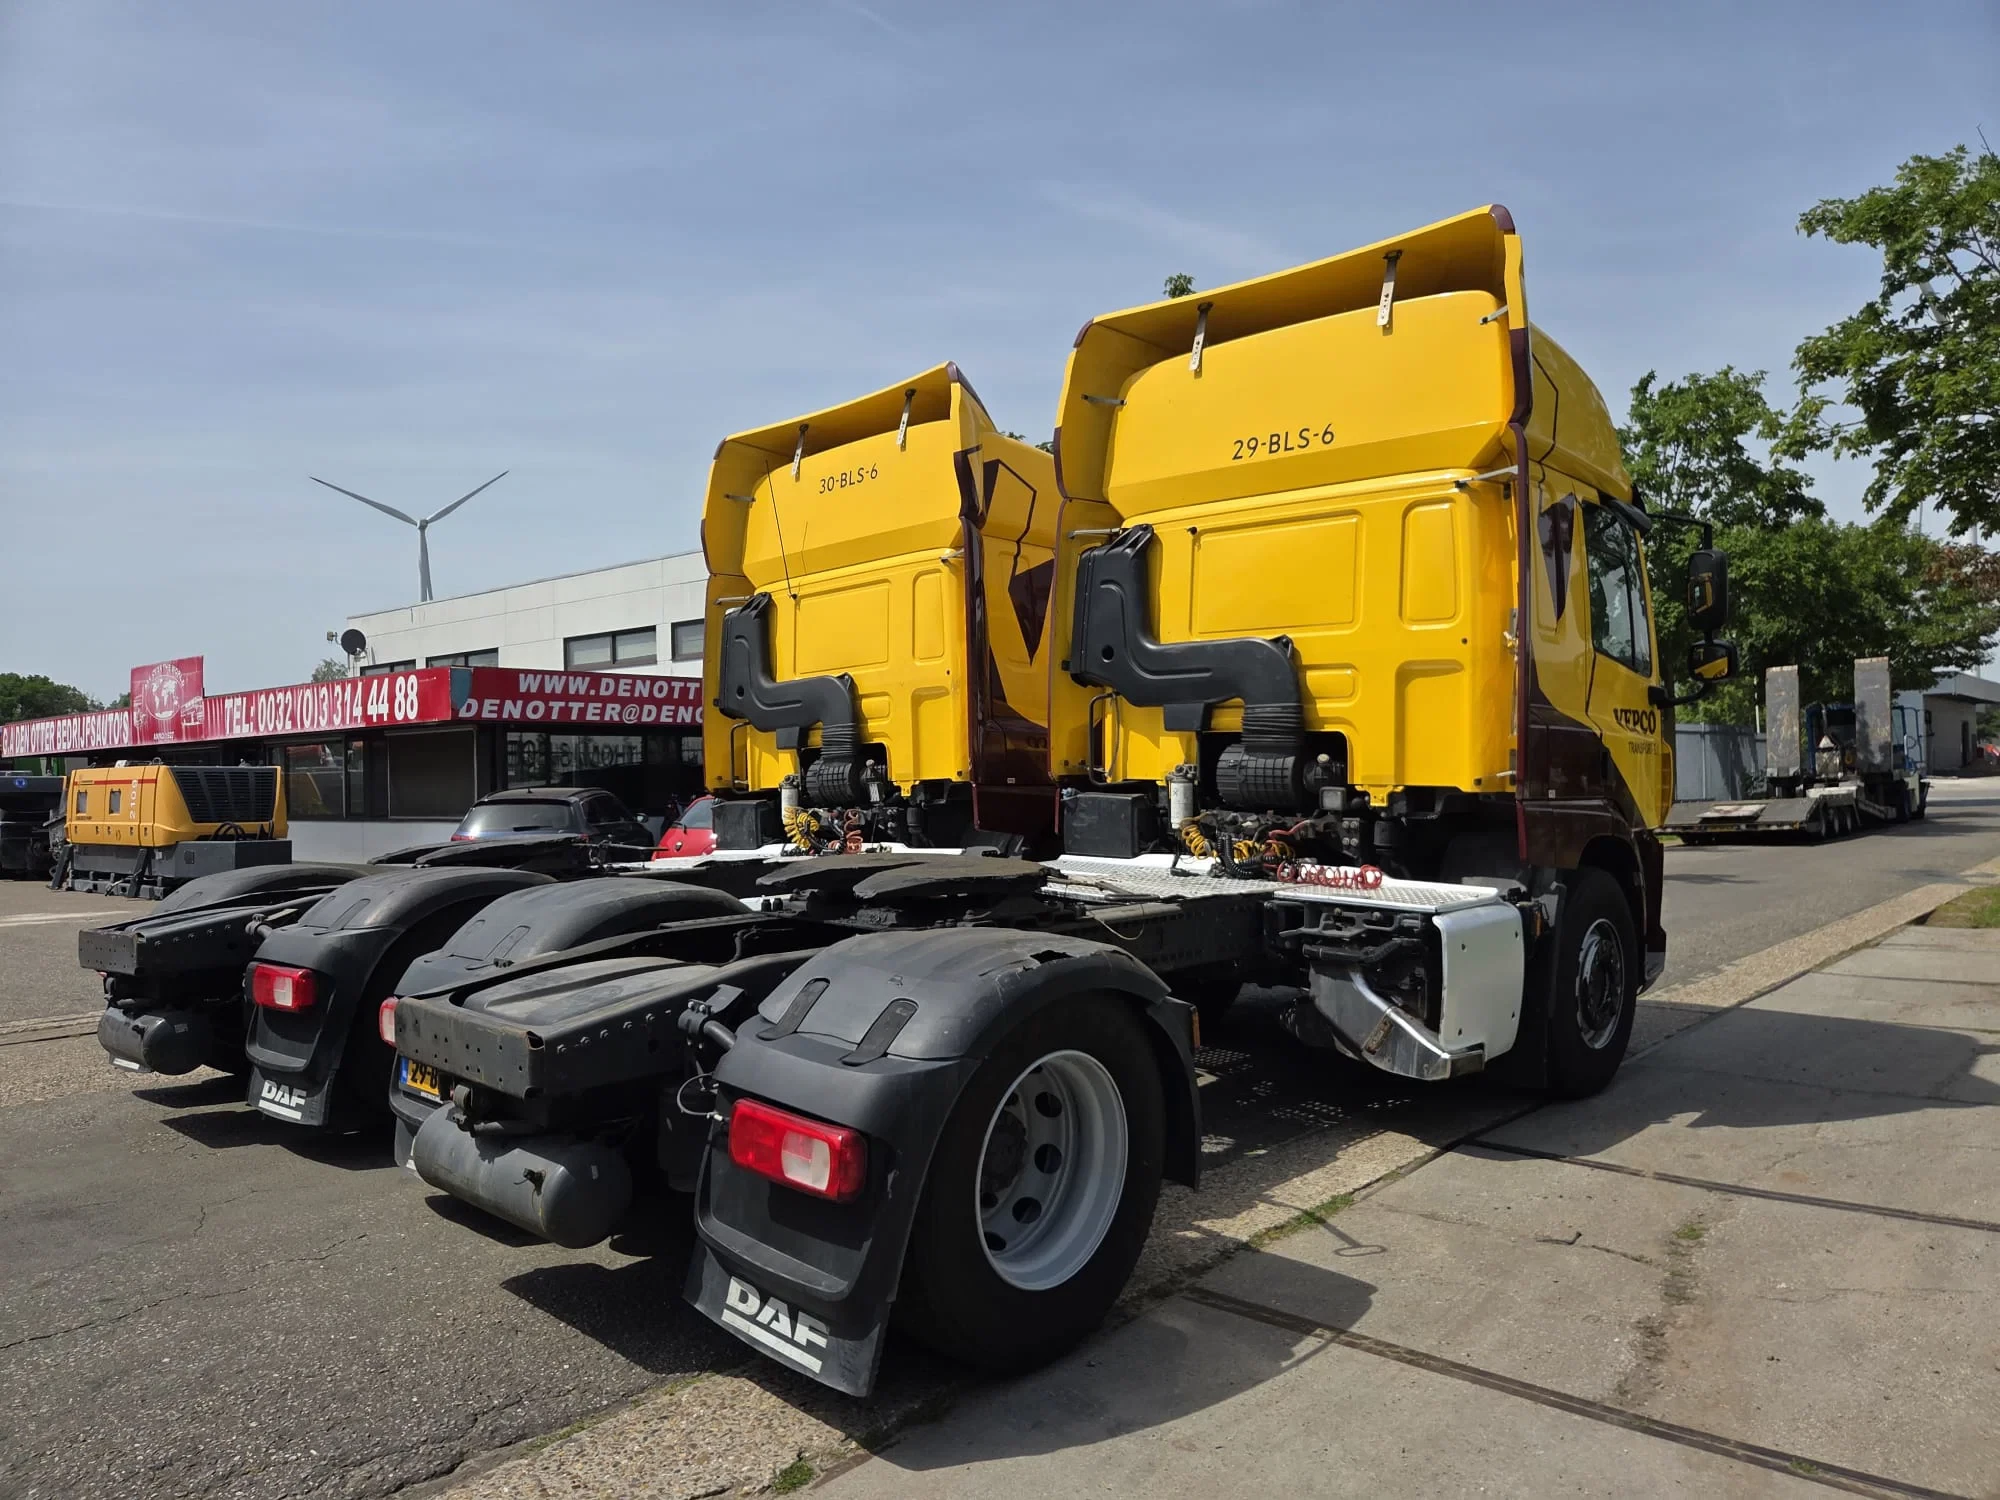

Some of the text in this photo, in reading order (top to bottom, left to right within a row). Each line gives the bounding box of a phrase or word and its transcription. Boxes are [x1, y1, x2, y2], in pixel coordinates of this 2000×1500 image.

[1232, 423, 1335, 460] 29-BLS-6
[819, 462, 878, 494] 30-BLS-6
[225, 697, 255, 736] TEL:
[258, 691, 292, 732] 0032
[367, 678, 390, 722] 44
[394, 674, 418, 721] 88
[30, 720, 55, 753] OTTER
[261, 1079, 307, 1107] DAF
[725, 1276, 830, 1349] DAF
